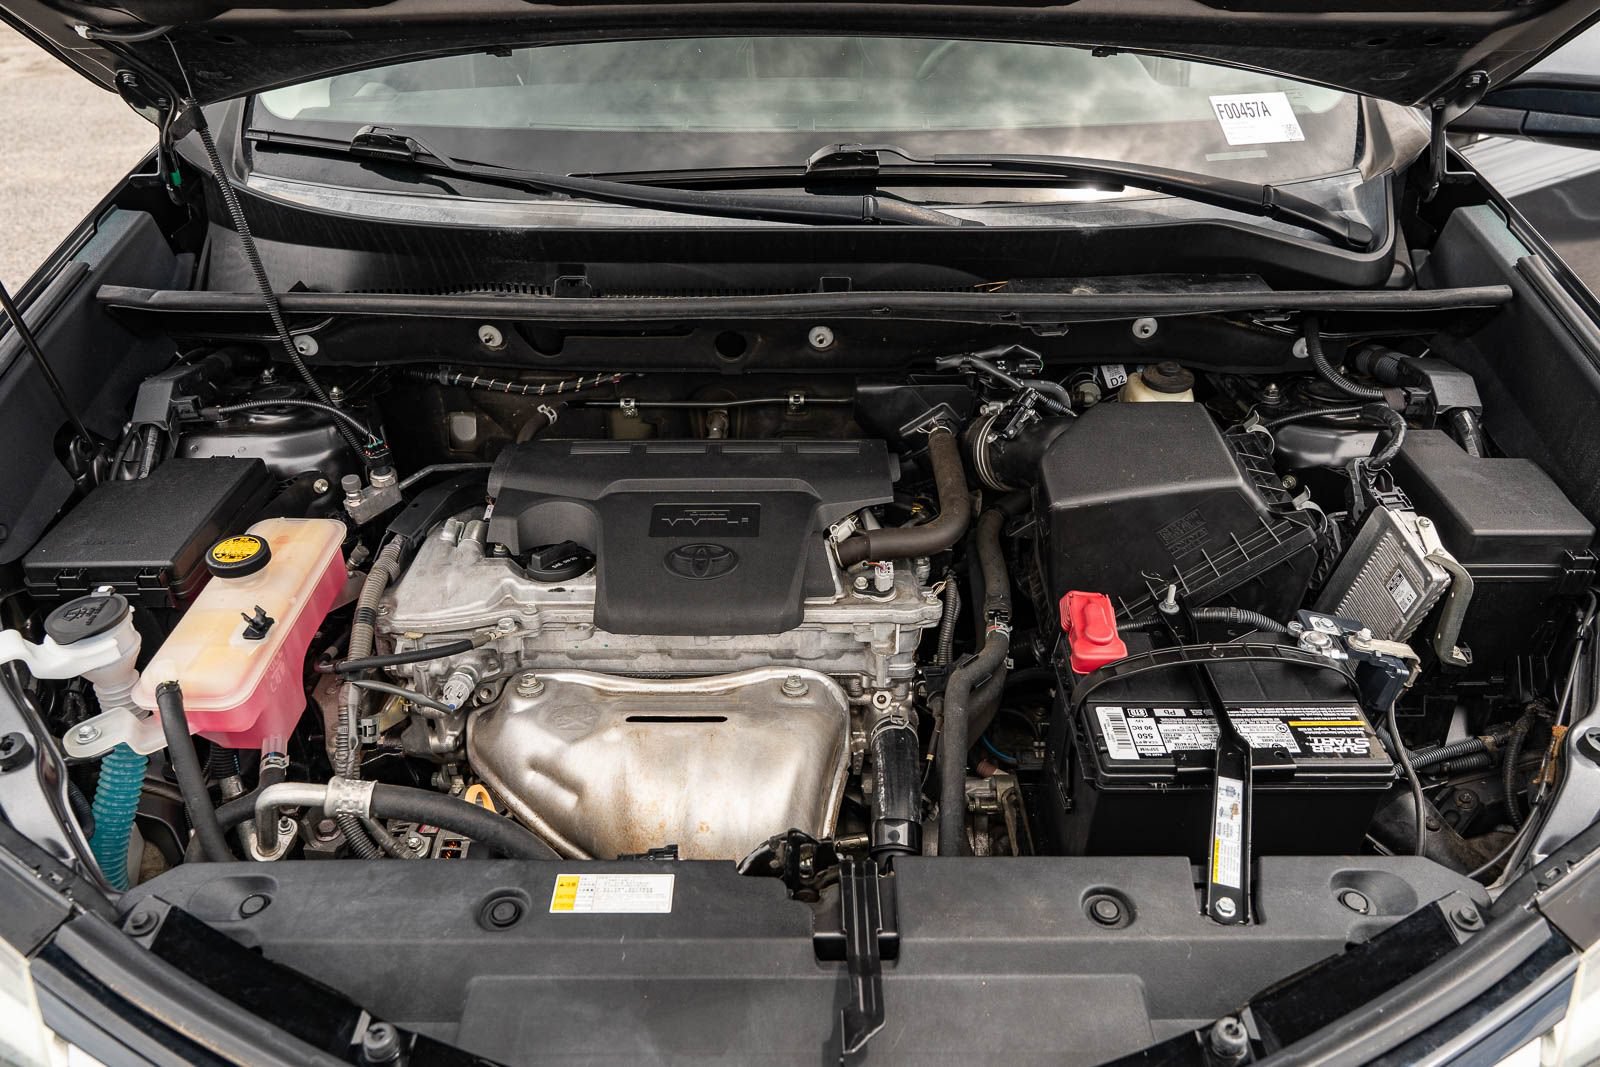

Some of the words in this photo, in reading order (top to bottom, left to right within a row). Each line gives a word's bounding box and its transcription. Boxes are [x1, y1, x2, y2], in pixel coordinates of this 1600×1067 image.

[1216, 100, 1272, 120] F00457A
[1110, 375, 1125, 386] D2
[1309, 737, 1370, 747] START
[1312, 745, 1368, 754] SUPER
